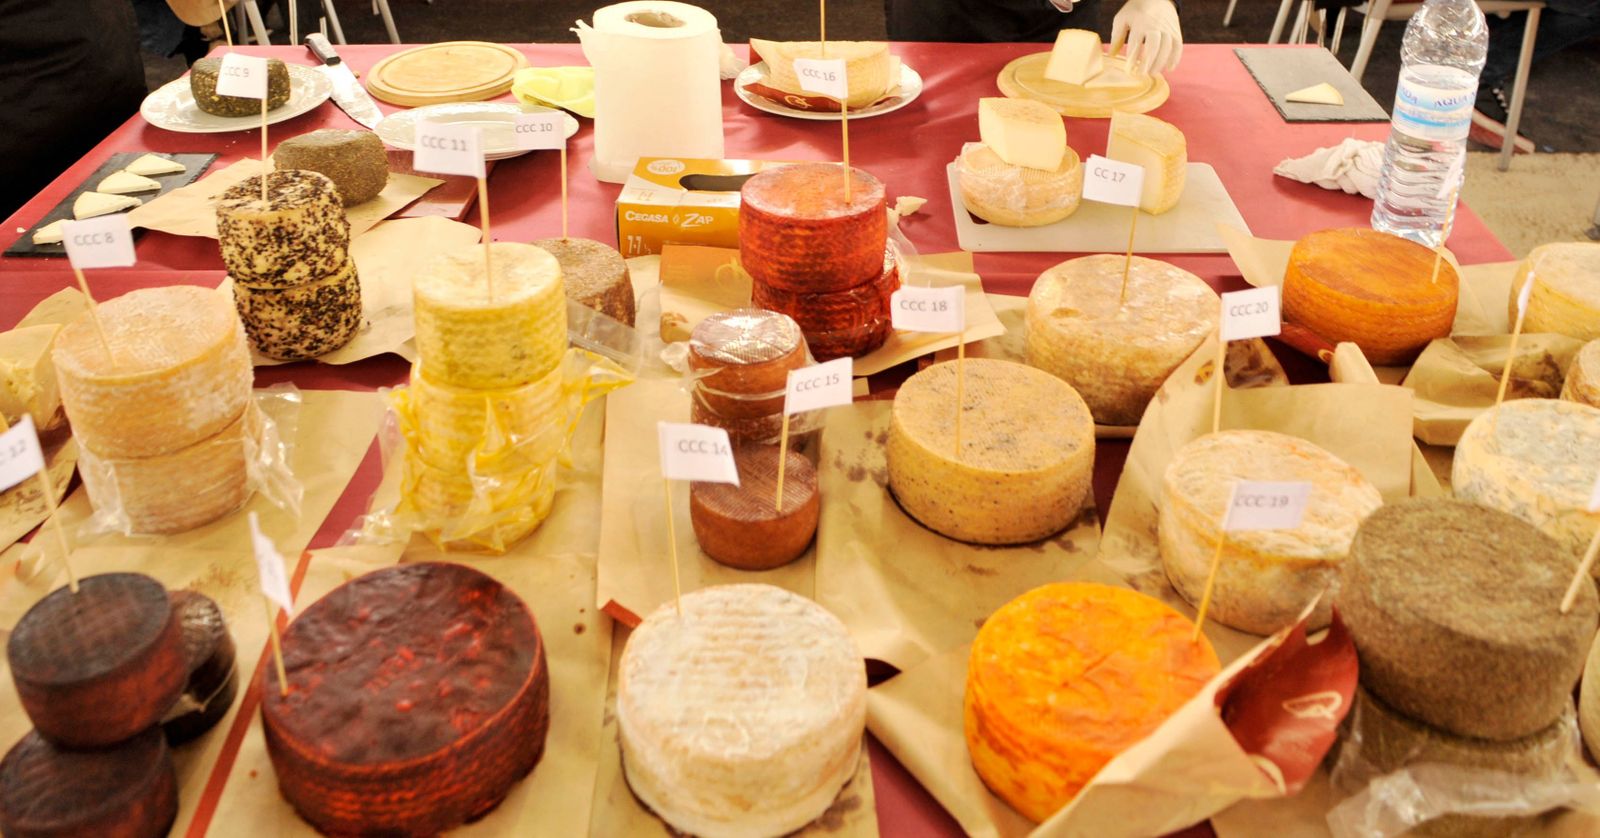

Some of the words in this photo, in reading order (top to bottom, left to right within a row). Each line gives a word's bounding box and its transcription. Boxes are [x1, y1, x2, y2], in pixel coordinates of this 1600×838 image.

[223, 66, 240, 77] CCC
[243, 67, 249, 78] 9
[802, 68, 821, 79] CCC
[823, 72, 836, 82] 16
[515, 123, 536, 133] CCC
[540, 123, 552, 132] 10
[421, 137, 447, 150] CCC
[452, 141, 468, 153] 11
[1113, 172, 1126, 183] 17
[625, 211, 669, 223] CEGASA
[681, 213, 714, 227] ZAP
[74, 233, 101, 246] CCC
[105, 232, 114, 243] 8
[900, 299, 926, 311] CCC
[931, 300, 947, 312] 18
[1230, 303, 1252, 317] CCC
[1255, 301, 1269, 314] 20
[796, 378, 821, 392] CCC
[825, 373, 839, 387] 15
[678, 440, 708, 453] CCC
[1235, 495, 1264, 508] CCC
[1270, 495, 1289, 508] 19
